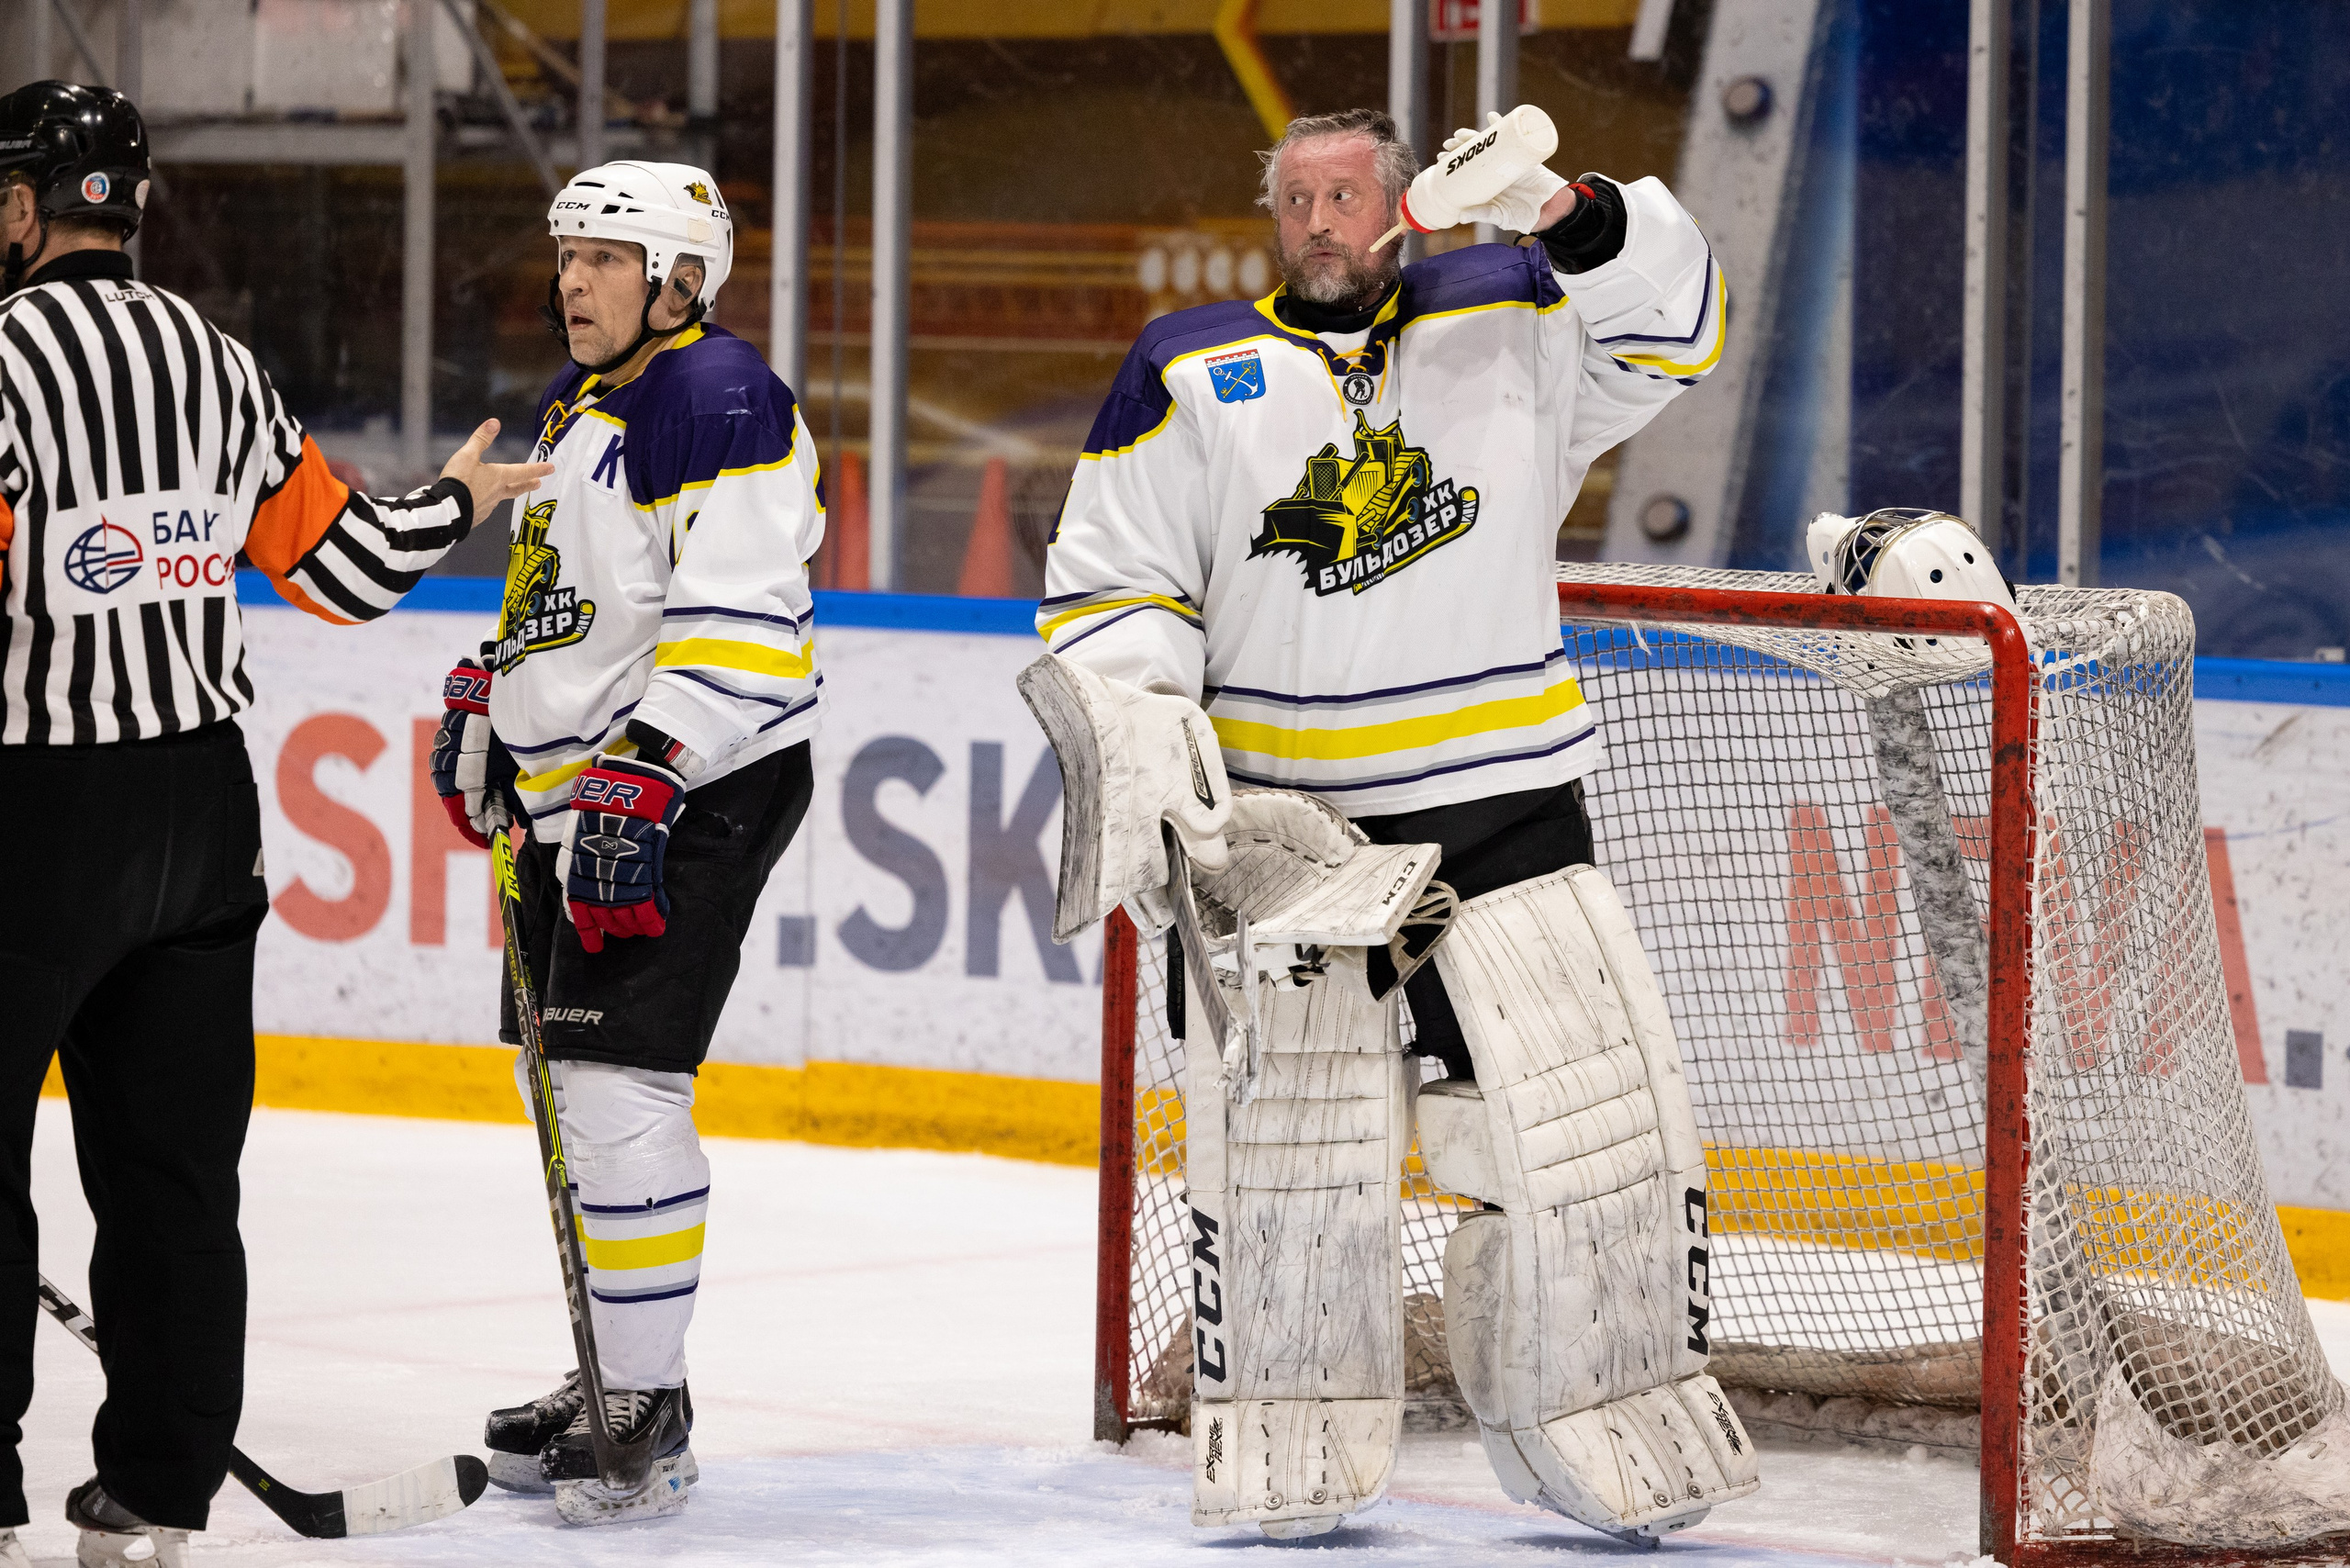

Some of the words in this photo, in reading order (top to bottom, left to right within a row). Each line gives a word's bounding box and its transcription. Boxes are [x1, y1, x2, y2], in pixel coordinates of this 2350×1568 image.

[555, 201, 591, 211] CCM
[105, 290, 155, 303] LUTCH
[1423, 483, 1456, 513] ХК
[1319, 504, 1458, 591] БУЛЬДОЗЕР
[544, 590, 573, 612] ХК
[502, 842, 520, 893] CCM
[1382, 861, 1418, 905] CCM
[1684, 1186, 1710, 1357] CCM
[1192, 1206, 1227, 1383] CCM
